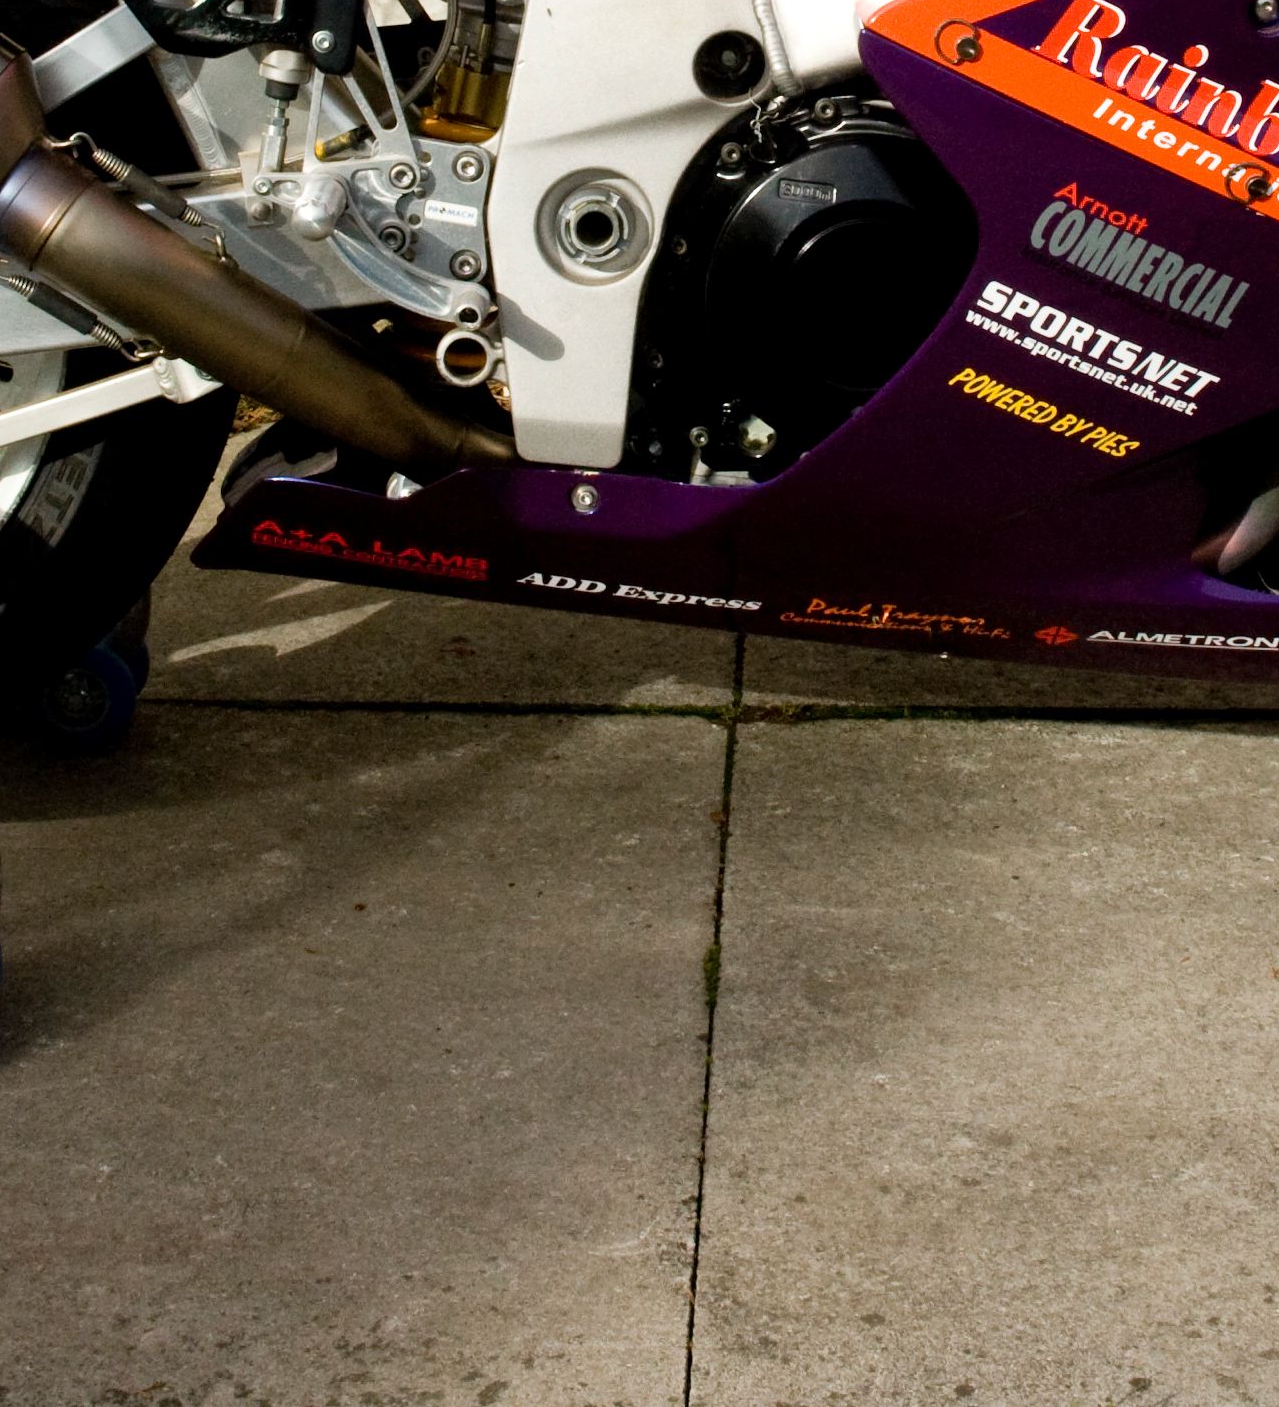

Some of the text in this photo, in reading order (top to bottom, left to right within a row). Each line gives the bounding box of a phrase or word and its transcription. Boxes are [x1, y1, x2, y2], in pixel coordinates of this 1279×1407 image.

[1053, 181, 1149, 236] Arnott
[1030, 199, 1250, 329] COMMERCIAL
[964, 308, 1199, 417] www.sportsnet.uk.net
[948, 367, 1141, 458] POWERED BY PIES
[372, 540, 489, 571] LAMB
[516, 571, 764, 612] ADD Express
[806, 597, 873, 618] Paul
